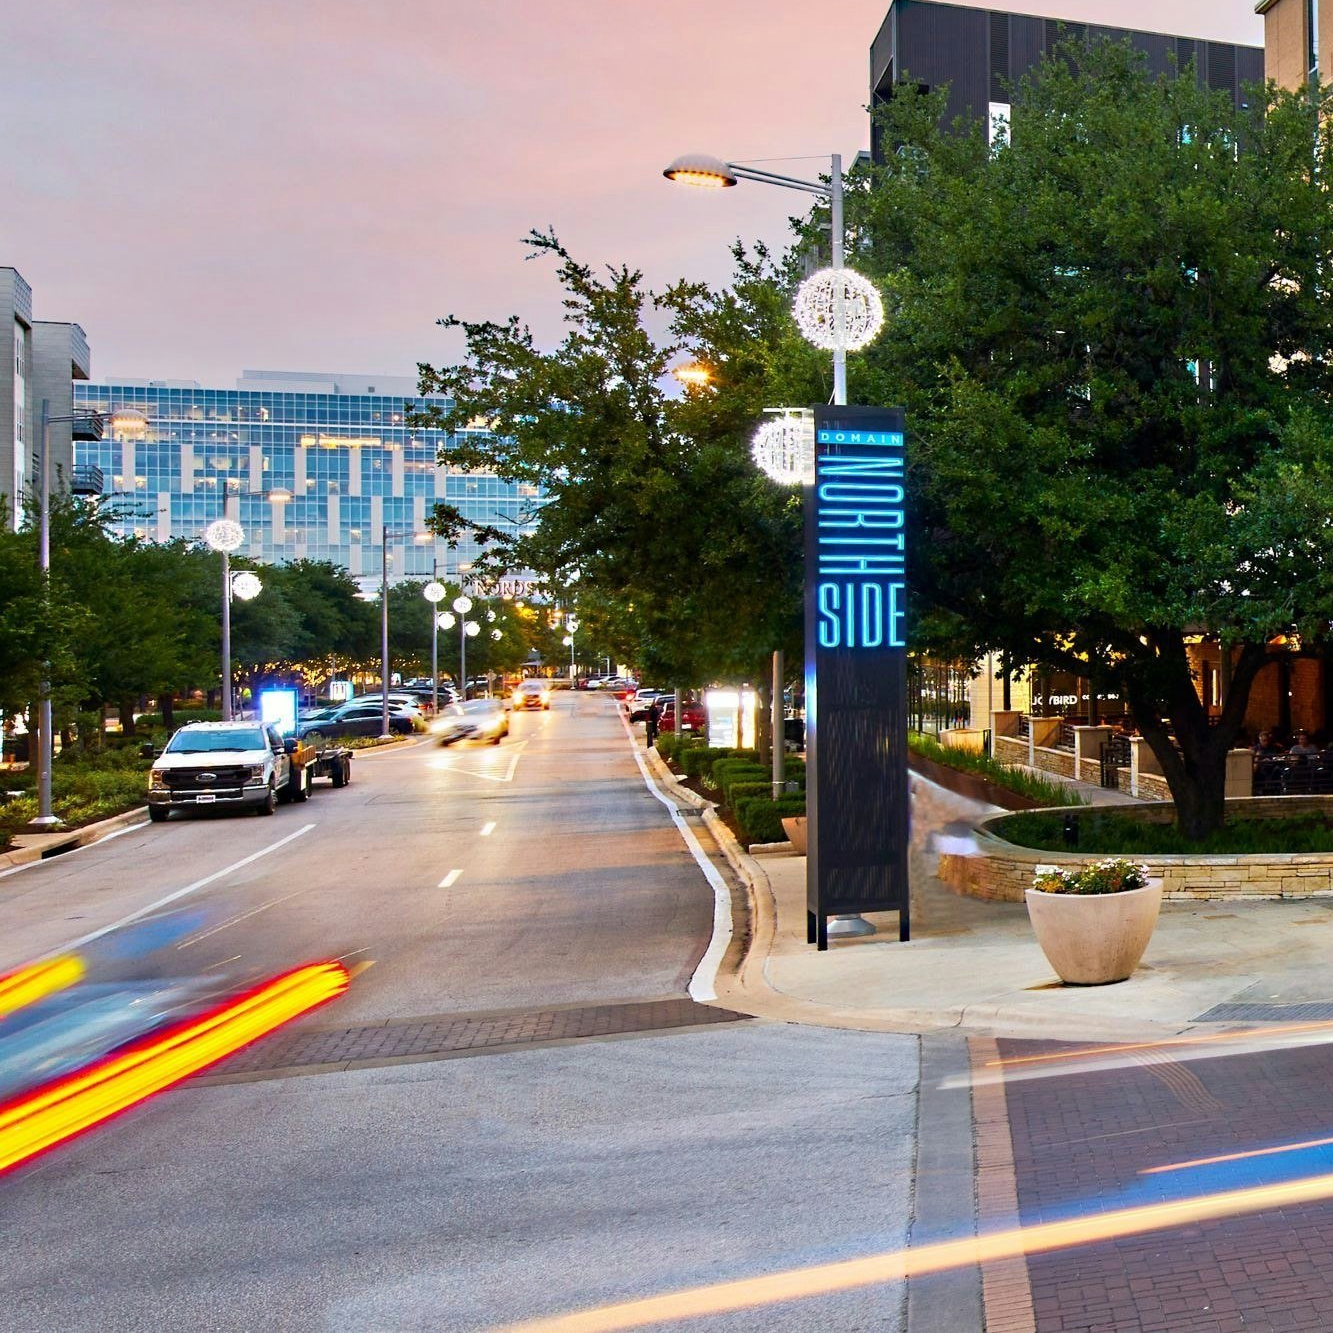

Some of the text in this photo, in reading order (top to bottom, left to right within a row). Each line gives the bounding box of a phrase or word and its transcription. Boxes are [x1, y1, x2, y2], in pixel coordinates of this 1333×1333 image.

[820, 432, 901, 444] DOMAIN
[818, 455, 905, 574] NORTH
[818, 582, 906, 648] SIDE
